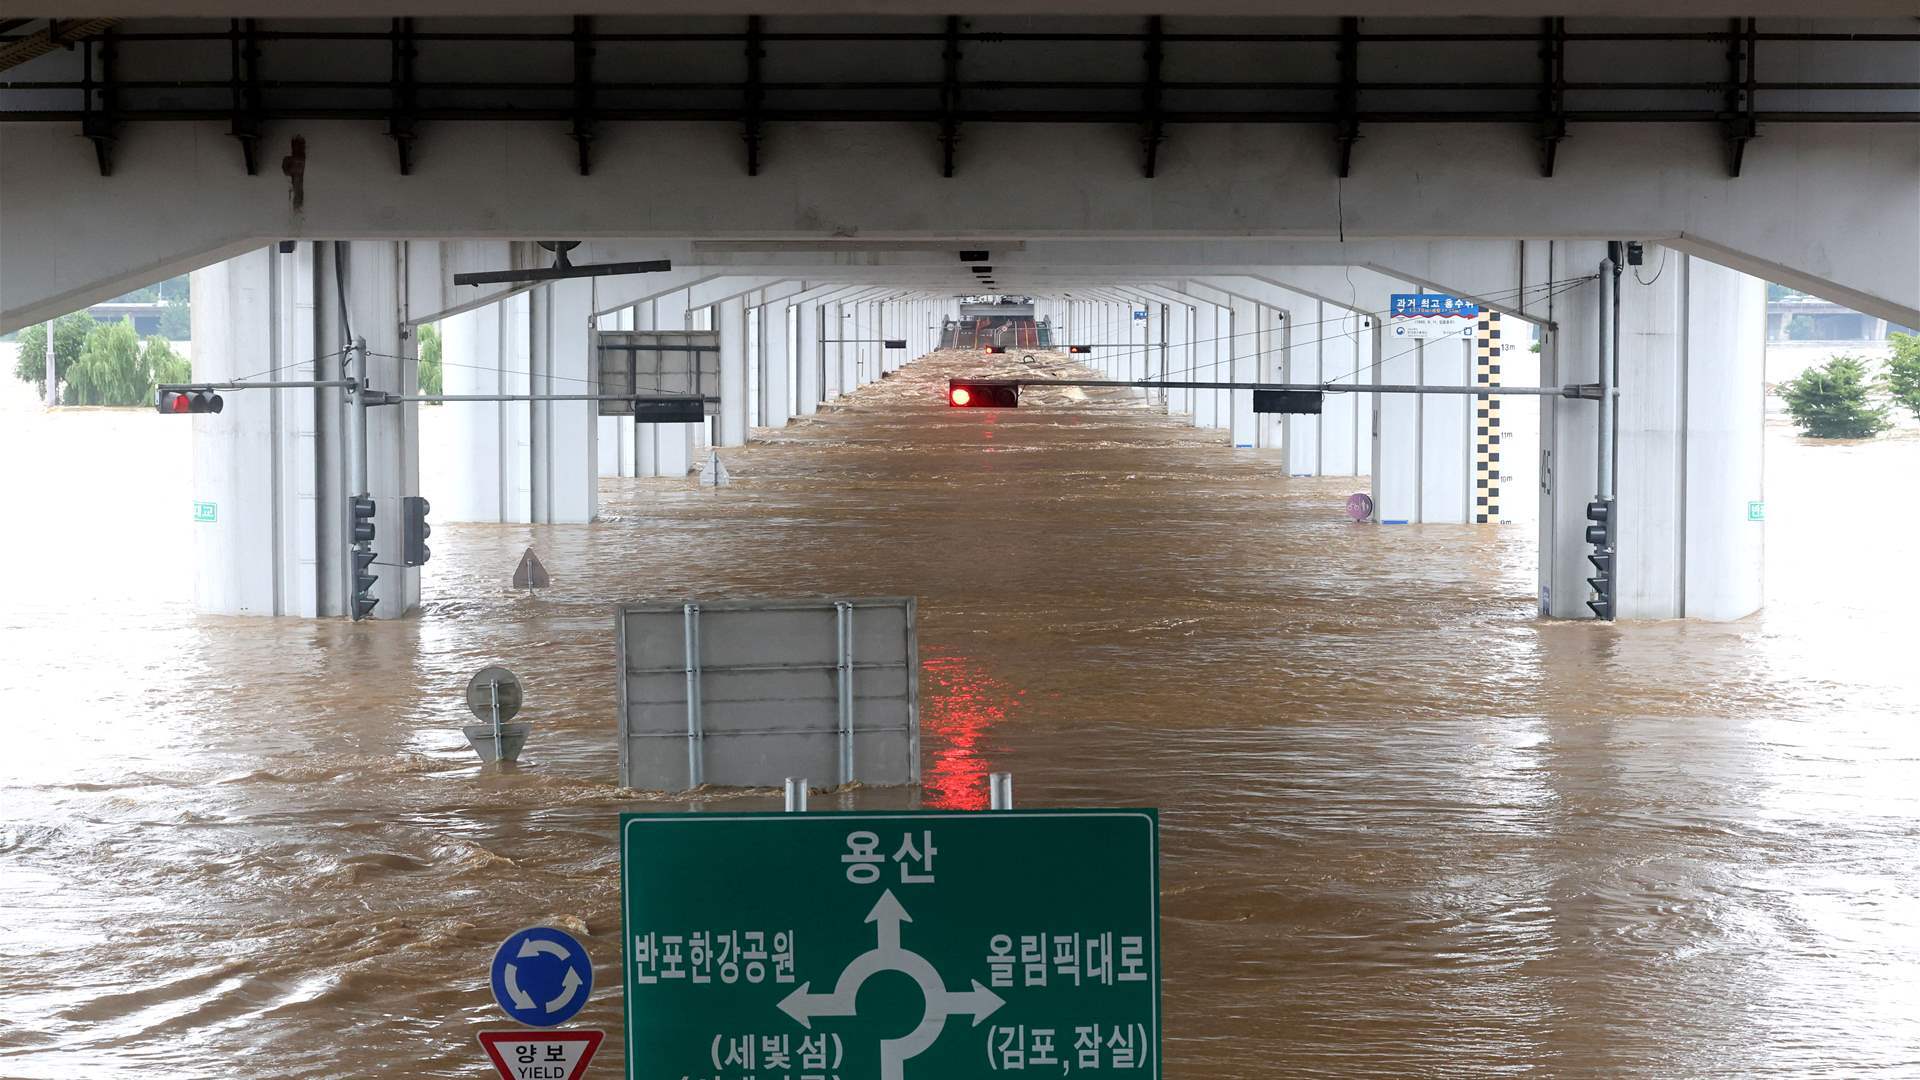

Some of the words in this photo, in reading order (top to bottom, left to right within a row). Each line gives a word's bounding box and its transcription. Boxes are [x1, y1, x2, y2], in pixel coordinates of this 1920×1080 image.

[1396, 298, 1416, 309] 과거
[1501, 343, 1516, 352] 13m
[1501, 431, 1513, 439] 11m
[841, 830, 938, 885] 용산
[634, 929, 796, 985] 반포한강공원
[986, 932, 1148, 987] 올림픽대로
[515, 1044, 567, 1064] 양보
[711, 1033, 843, 1070] (세빛섬)
[518, 1066, 565, 1079] YIELD
